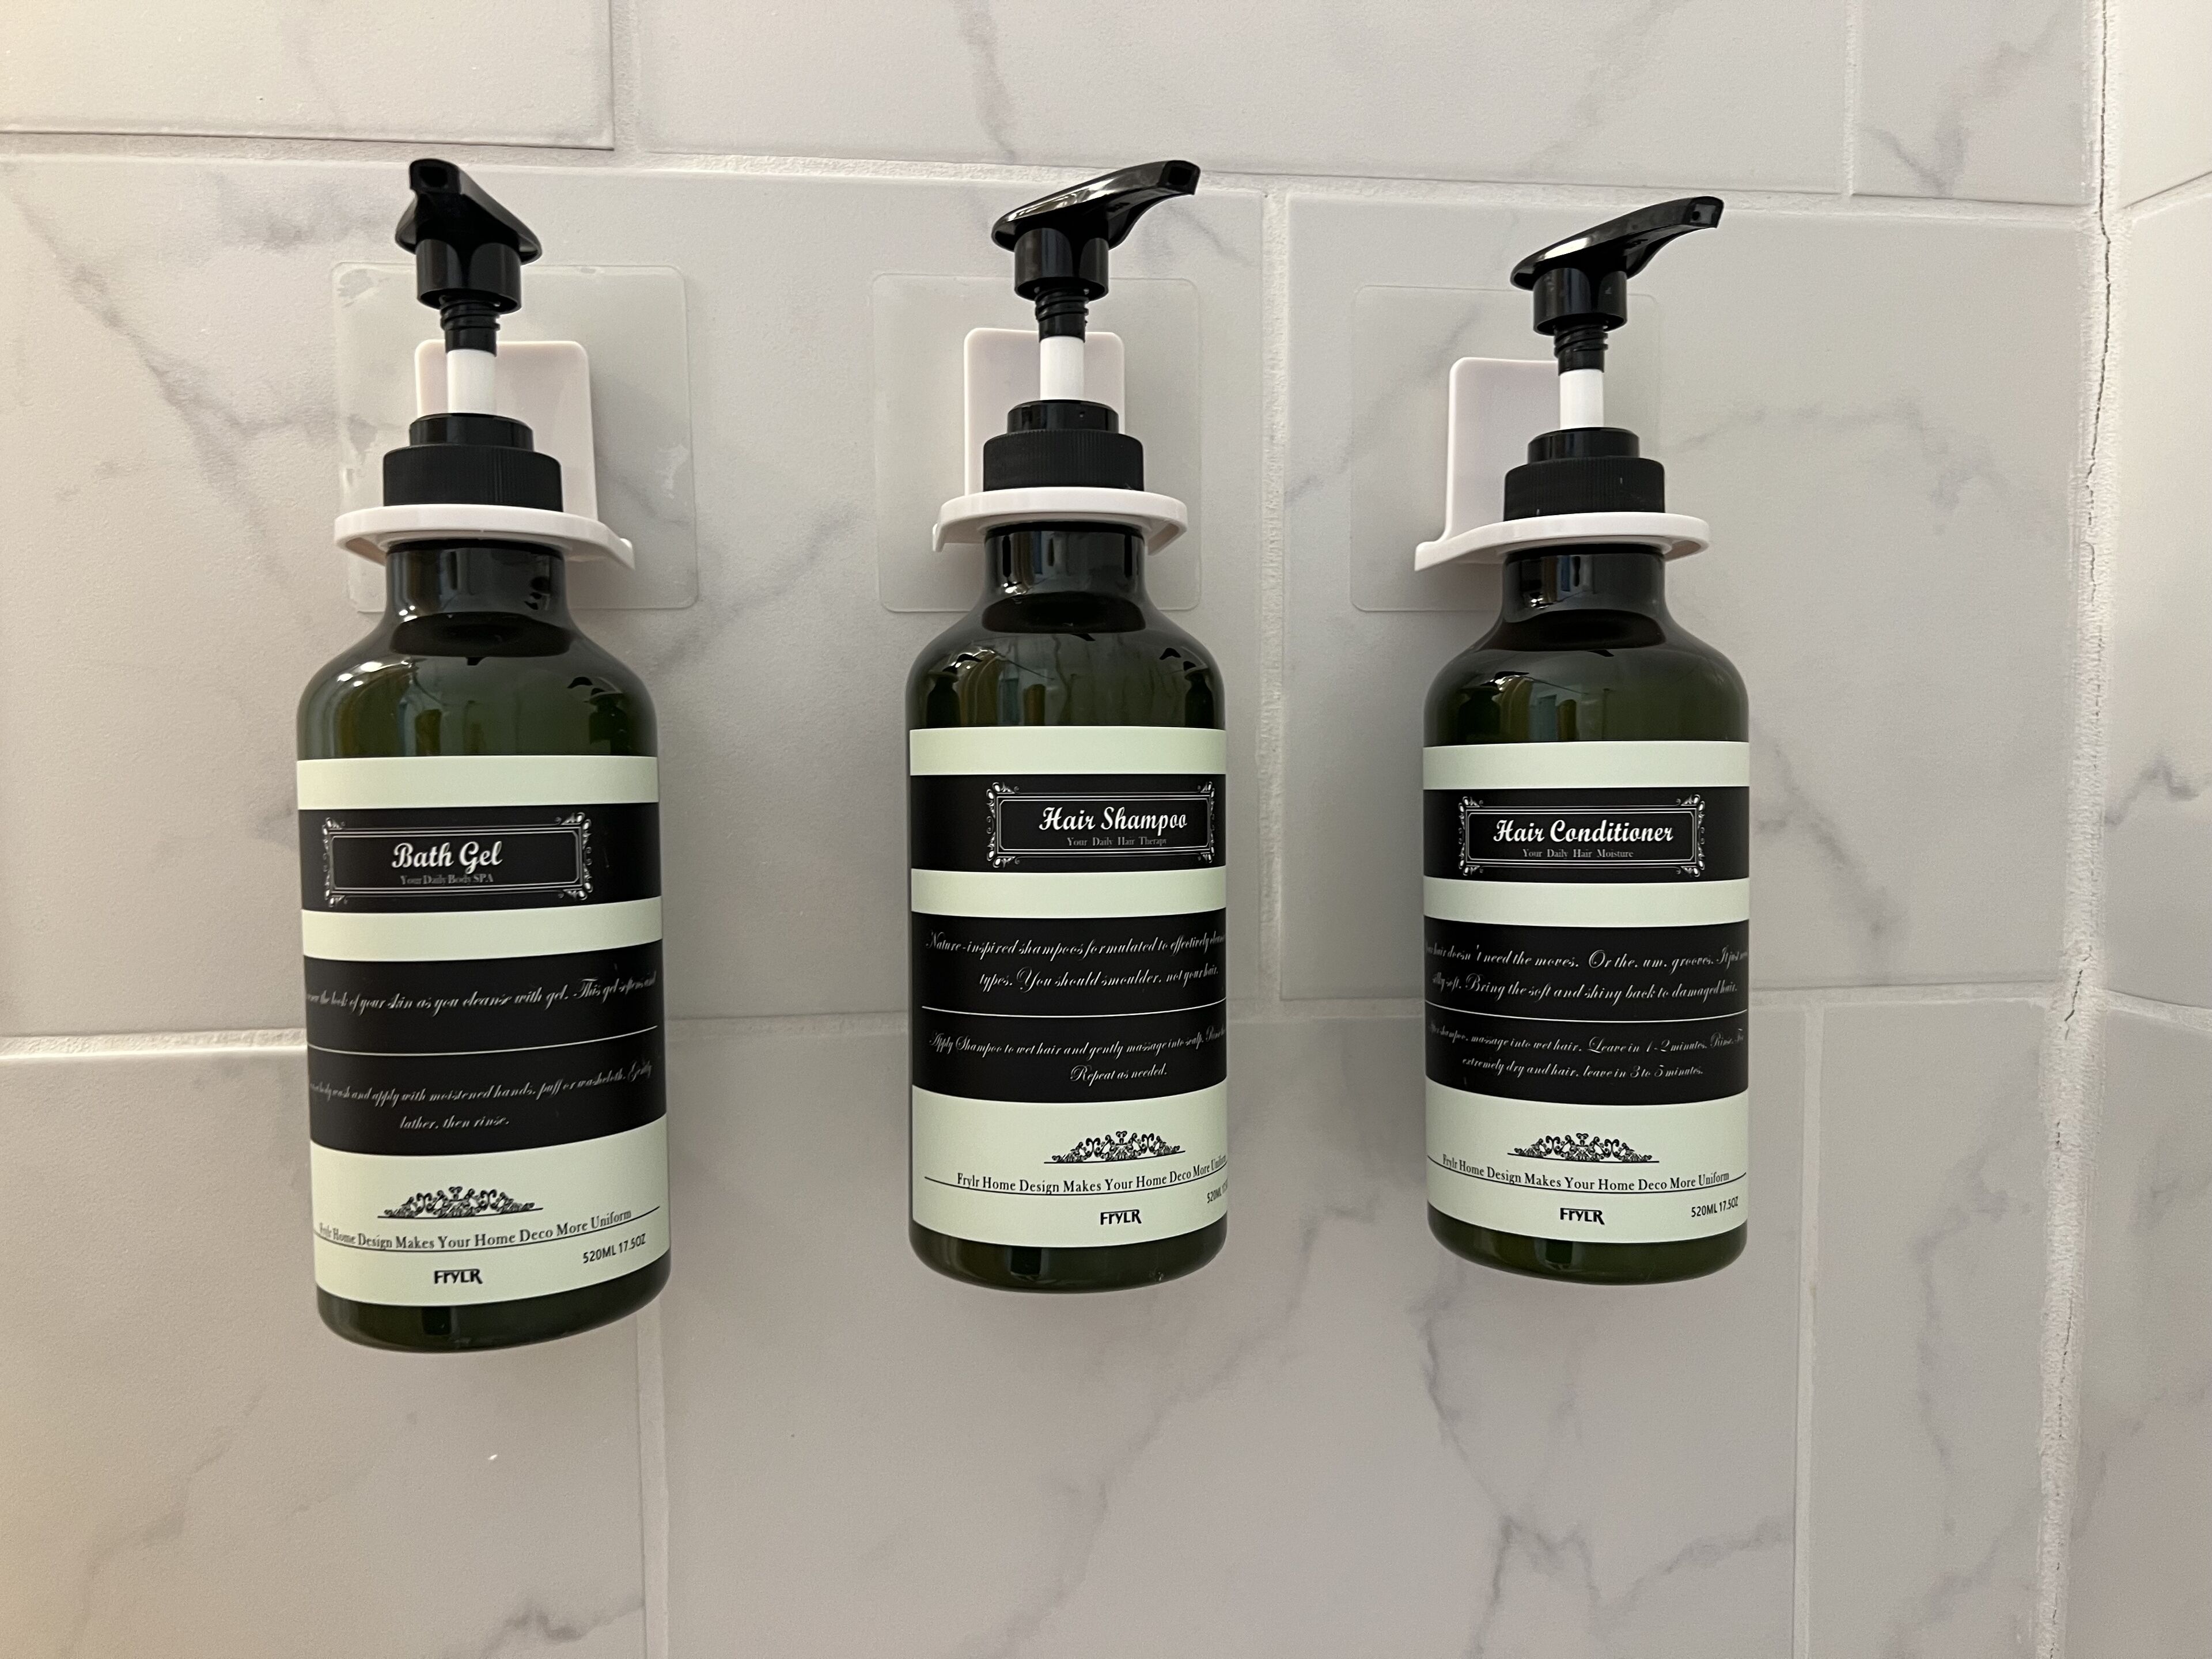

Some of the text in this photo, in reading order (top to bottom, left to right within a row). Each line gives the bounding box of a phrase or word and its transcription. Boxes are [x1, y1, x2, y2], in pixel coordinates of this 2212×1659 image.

[1039, 806, 1188, 836] Hair Shampoo
[1493, 819, 1673, 843] Hair Conditioner
[1067, 836, 1167, 847] Your Daily Hair Therapy
[392, 841, 502, 874] Bath Gel
[1522, 849, 1634, 859] Your Daily Hair Moisture
[400, 874, 494, 885] Your Daily Body SPA
[925, 930, 1020, 961] Nature-inspired
[1018, 940, 1084, 962] shampoos
[1078, 937, 1158, 961] formulated
[1158, 940, 1168, 951] to
[1483, 950, 1513, 964] need
[1512, 950, 1532, 965] the
[1588, 949, 1612, 968] Or
[979, 974, 1013, 993] types.
[1016, 966, 1052, 993] You
[1055, 971, 1102, 987] should
[1166, 970, 1183, 982] not
[1183, 969, 1203, 988] your
[1465, 972, 1506, 1002] Bring
[1508, 980, 1527, 995] the
[1553, 984, 1585, 998] and
[1584, 984, 1622, 1007] shiny
[1625, 983, 1656, 999] back
[1657, 987, 1669, 998] to
[1671, 979, 1721, 1004] damaged
[349, 993, 361, 1013] of
[359, 999, 386, 1016] your
[388, 993, 412, 1009] skin
[416, 997, 432, 1009] as
[432, 999, 459, 1017] you
[463, 991, 512, 1006] cleanse
[514, 987, 543, 1004] with
[573, 978, 600, 998] This
[955, 1036, 1002, 1058] Shampoo
[1003, 1044, 1014, 1054] to
[1016, 1046, 1035, 1055] wet
[1036, 1042, 1062, 1055] hair
[1064, 1041, 1089, 1055] and
[1087, 1040, 1123, 1060] gently
[1126, 1041, 1166, 1056] massage
[1168, 1039, 1184, 1049] into
[1471, 1036, 1509, 1052] massage
[1509, 1038, 1531, 1048] into
[1533, 1040, 1552, 1050] wet
[1627, 1043, 1640, 1053] in
[1070, 1063, 1167, 1087] Repeat as needed.
[1462, 1057, 1505, 1076] extremely
[1506, 1060, 1525, 1078] dry
[1527, 1063, 1552, 1075] and
[1583, 1065, 1613, 1078] leave
[1614, 1068, 1627, 1078] in
[1630, 1066, 1641, 1078] 3
[1641, 1069, 1651, 1078] to
[1654, 1065, 1664, 1078] 5
[352, 1087, 373, 1100] and
[372, 1088, 400, 1108] apply
[402, 1088, 426, 1101] with
[429, 1085, 494, 1101] moistened
[535, 1078, 563, 1101] puff
[442, 1115, 471, 1128] then
[957, 1164, 1210, 1194] Frylr Home Design Makes Your Home Deco More
[1459, 1160, 1484, 1177] Home
[1487, 1166, 1522, 1184] Design
[1524, 1172, 1562, 1188] Makes
[1563, 1177, 1595, 1191] Your
[1597, 1177, 1635, 1191] Home
[1638, 1177, 1668, 1191] Deco
[1670, 1176, 1696, 1189] More
[1698, 1171, 1730, 1186] Uniform
[1691, 1205, 1718, 1218] 520ML
[358, 1233, 393, 1251] Design
[395, 1234, 435, 1249] Makes
[438, 1234, 471, 1249] Your
[474, 1232, 516, 1247] Home
[519, 1228, 553, 1243] Deco
[556, 1222, 589, 1238] More
[590, 1210, 632, 1230] Uniform
[582, 1244, 617, 1264] 520ML
